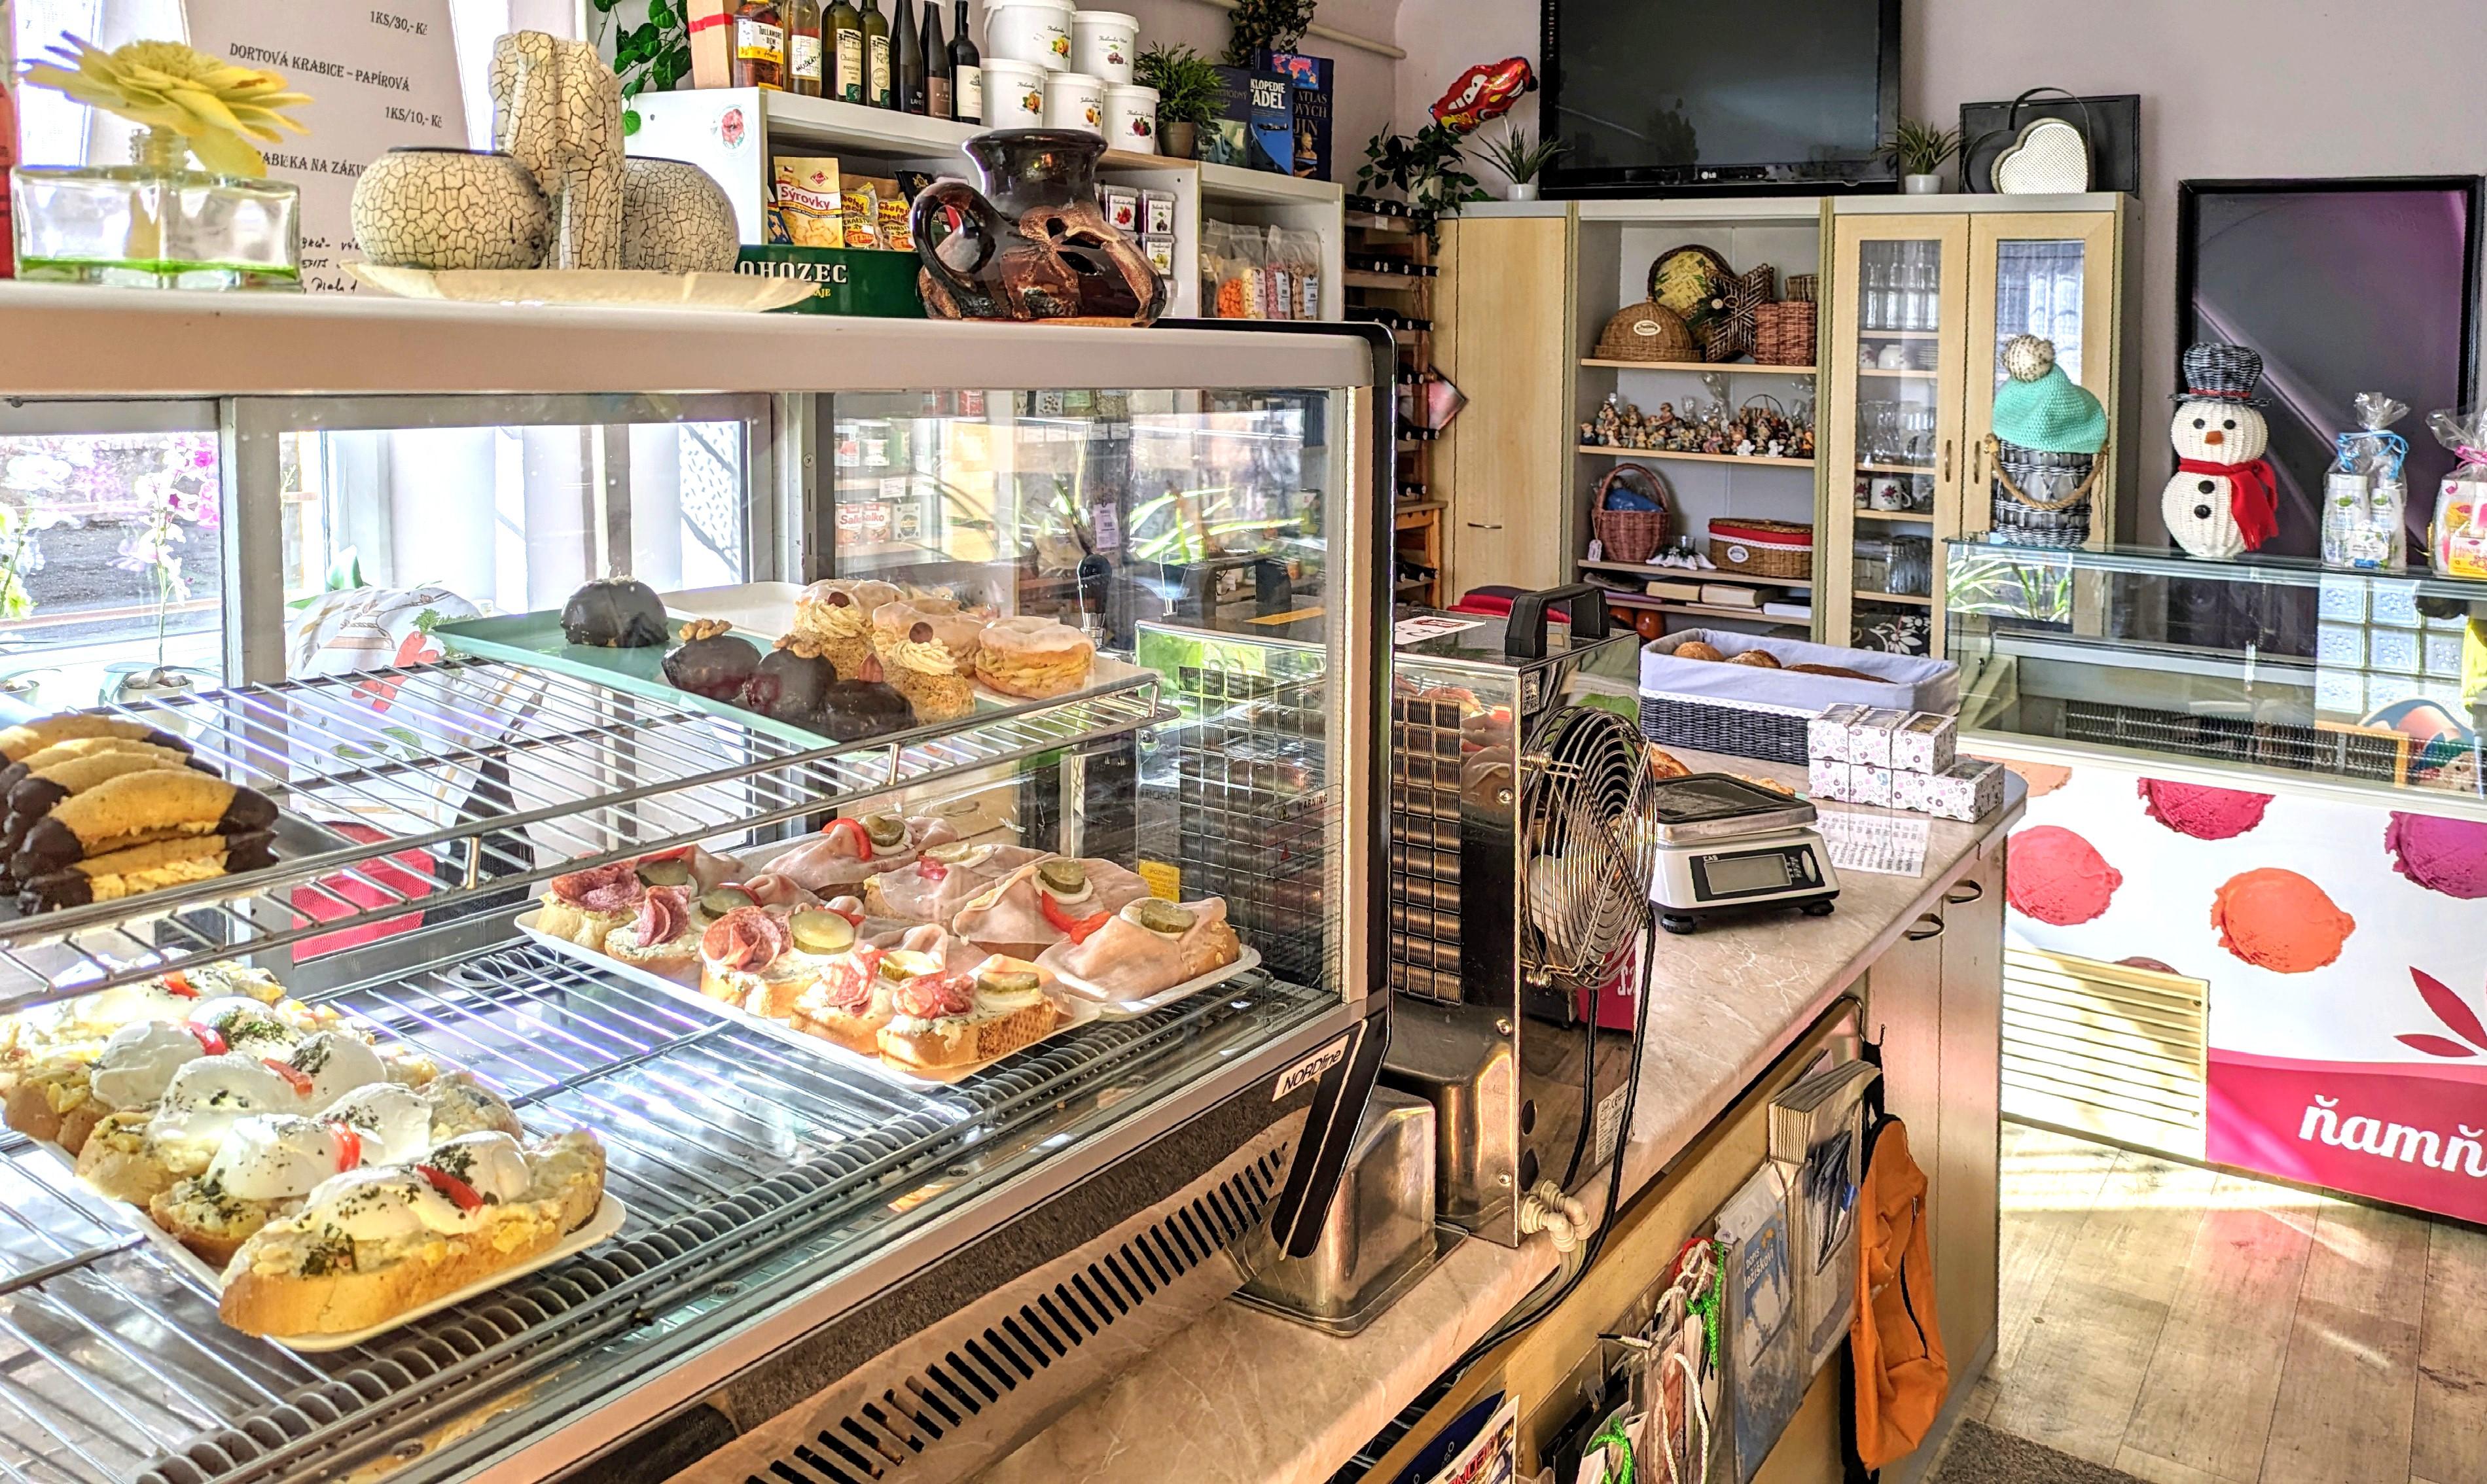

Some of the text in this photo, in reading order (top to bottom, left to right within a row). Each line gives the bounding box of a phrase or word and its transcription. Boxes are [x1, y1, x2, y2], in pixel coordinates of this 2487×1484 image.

[230, 43, 289, 67] DORTOVÁ
[292, 56, 344, 78] KRABICE
[355, 69, 410, 92] PAPÍROVÁ
[1250, 78, 1285, 93] KLOPEDIE
[1251, 89, 1285, 109] ADEL
[1298, 90, 1327, 103] ATLAS
[385, 106, 429, 126] 1KS/10,-
[1293, 118, 1318, 135] JIN
[311, 158, 327, 173] NA
[781, 186, 830, 210] Sýrovky
[739, 260, 847, 283] OHOZEC
[1297, 794, 1328, 812] WARNING
